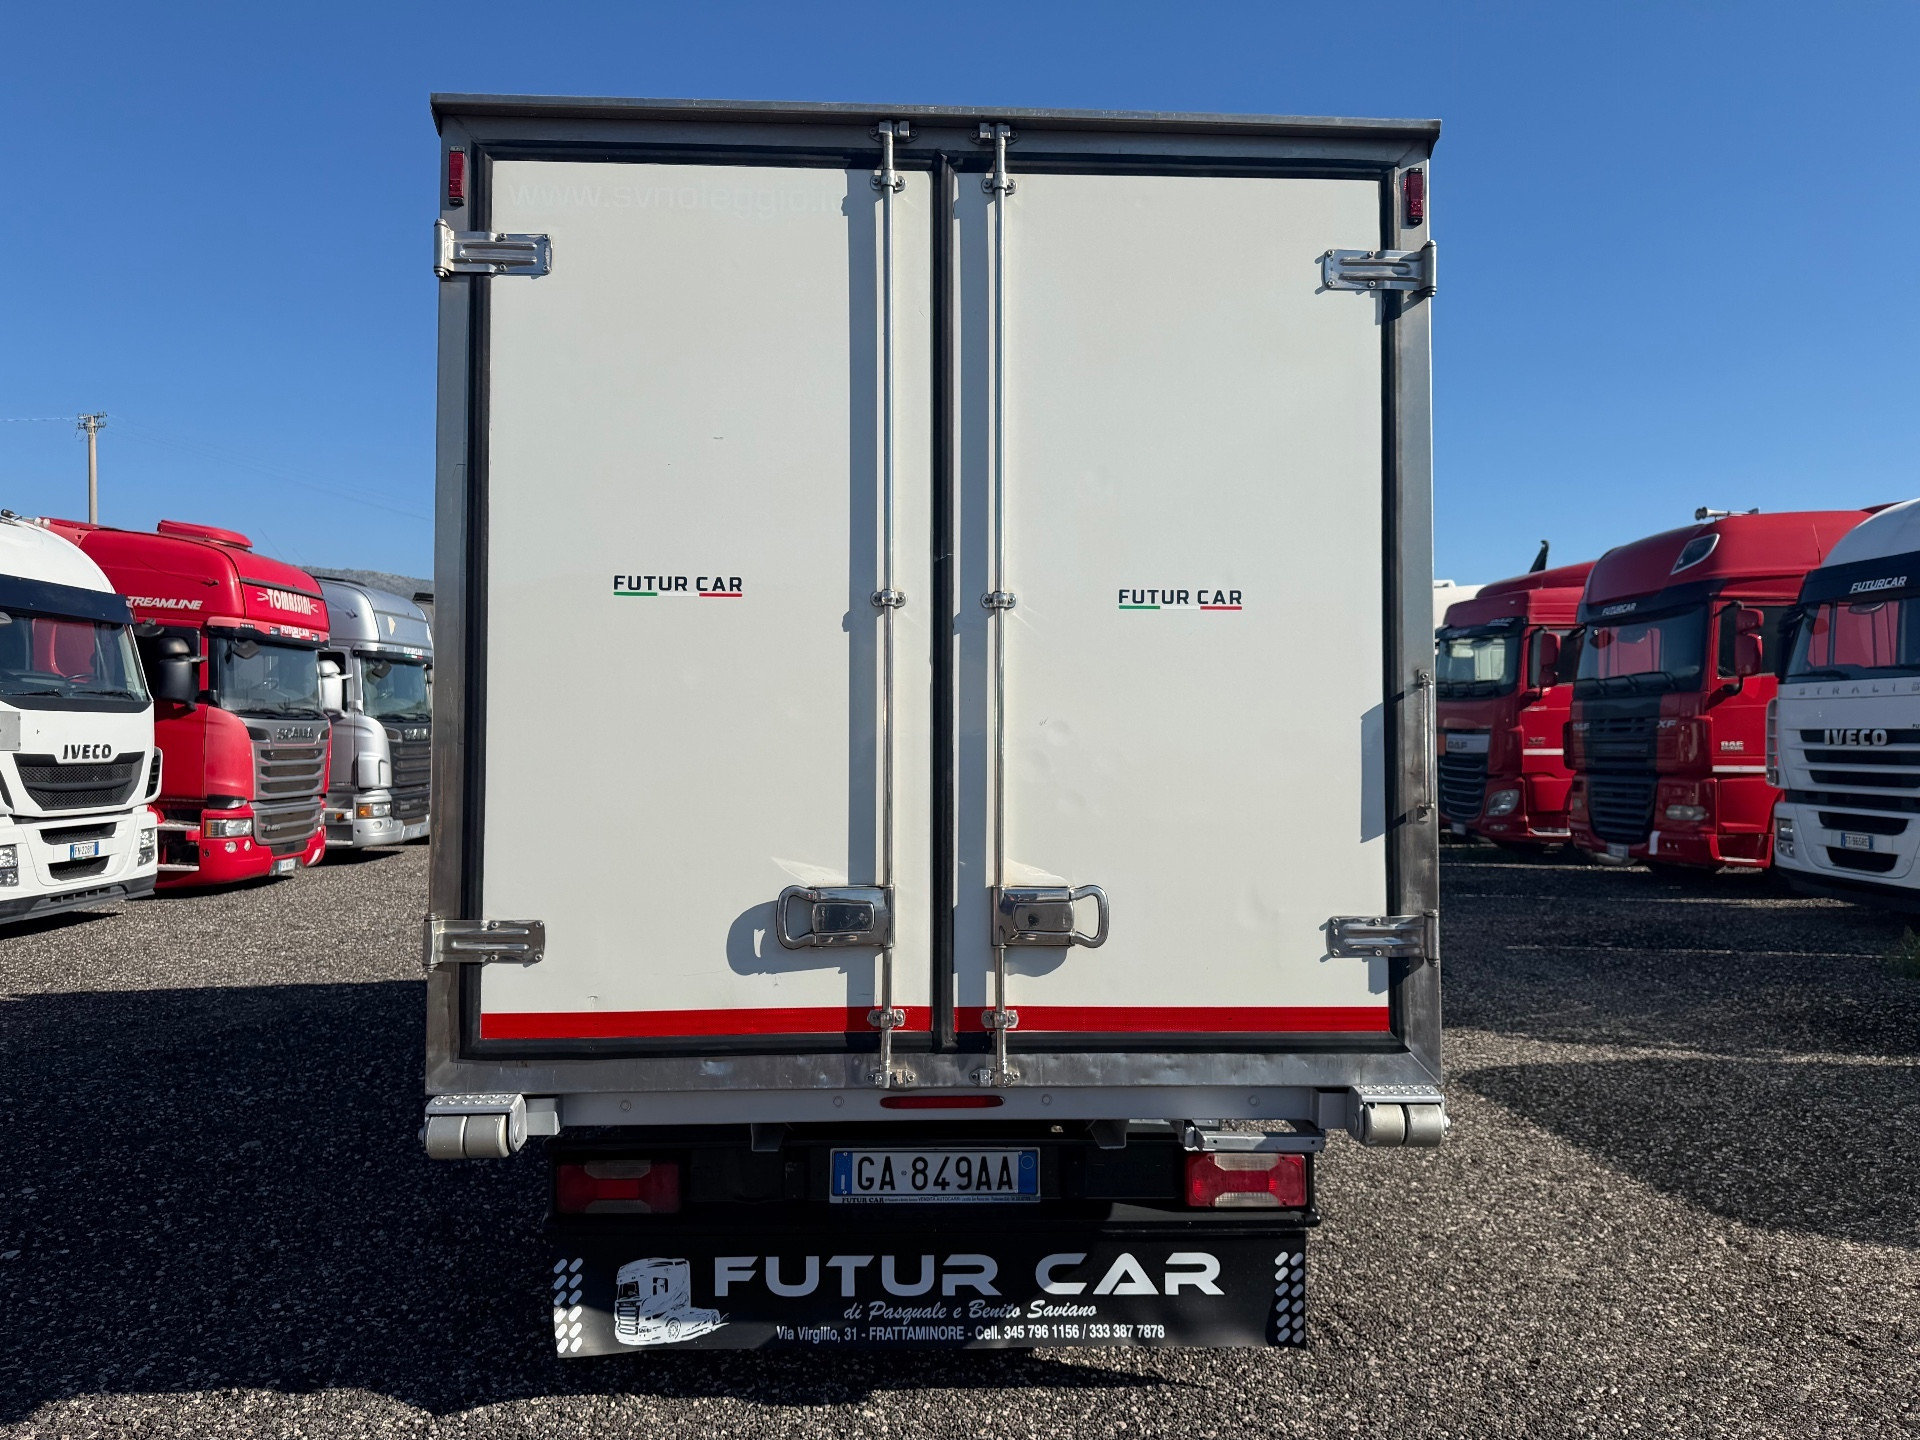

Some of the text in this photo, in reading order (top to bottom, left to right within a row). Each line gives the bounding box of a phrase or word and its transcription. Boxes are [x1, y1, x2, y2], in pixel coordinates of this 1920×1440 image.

[613, 575, 742, 592] FUTUR CAR
[1849, 576, 1908, 594] FUTURCAR
[1118, 589, 1242, 605] FUTUR CAR
[1824, 729, 1888, 747] IVECO
[62, 743, 112, 760] IVECO
[857, 1155, 896, 1191] GA
[911, 1156, 1013, 1191] 849AA
[714, 1252, 1225, 1297] FUTUR CAR
[844, 1299, 1097, 1324] di Pasquale e Benito Saviano
[776, 1325, 794, 1341] Via
[797, 1325, 841, 1344] Virgilio,
[844, 1326, 858, 1341] 31
[869, 1325, 965, 1341] FRATTAMINORE
[975, 1325, 1001, 1340] Cell.
[1003, 1325, 1025, 1340] 345
[1027, 1325, 1049, 1340] 796
[1052, 1324, 1080, 1339] 1156
[1081, 1324, 1087, 1339] /
[1089, 1324, 1111, 1339] 333
[1113, 1324, 1133, 1339] 387
[1137, 1324, 1165, 1339] 7878
